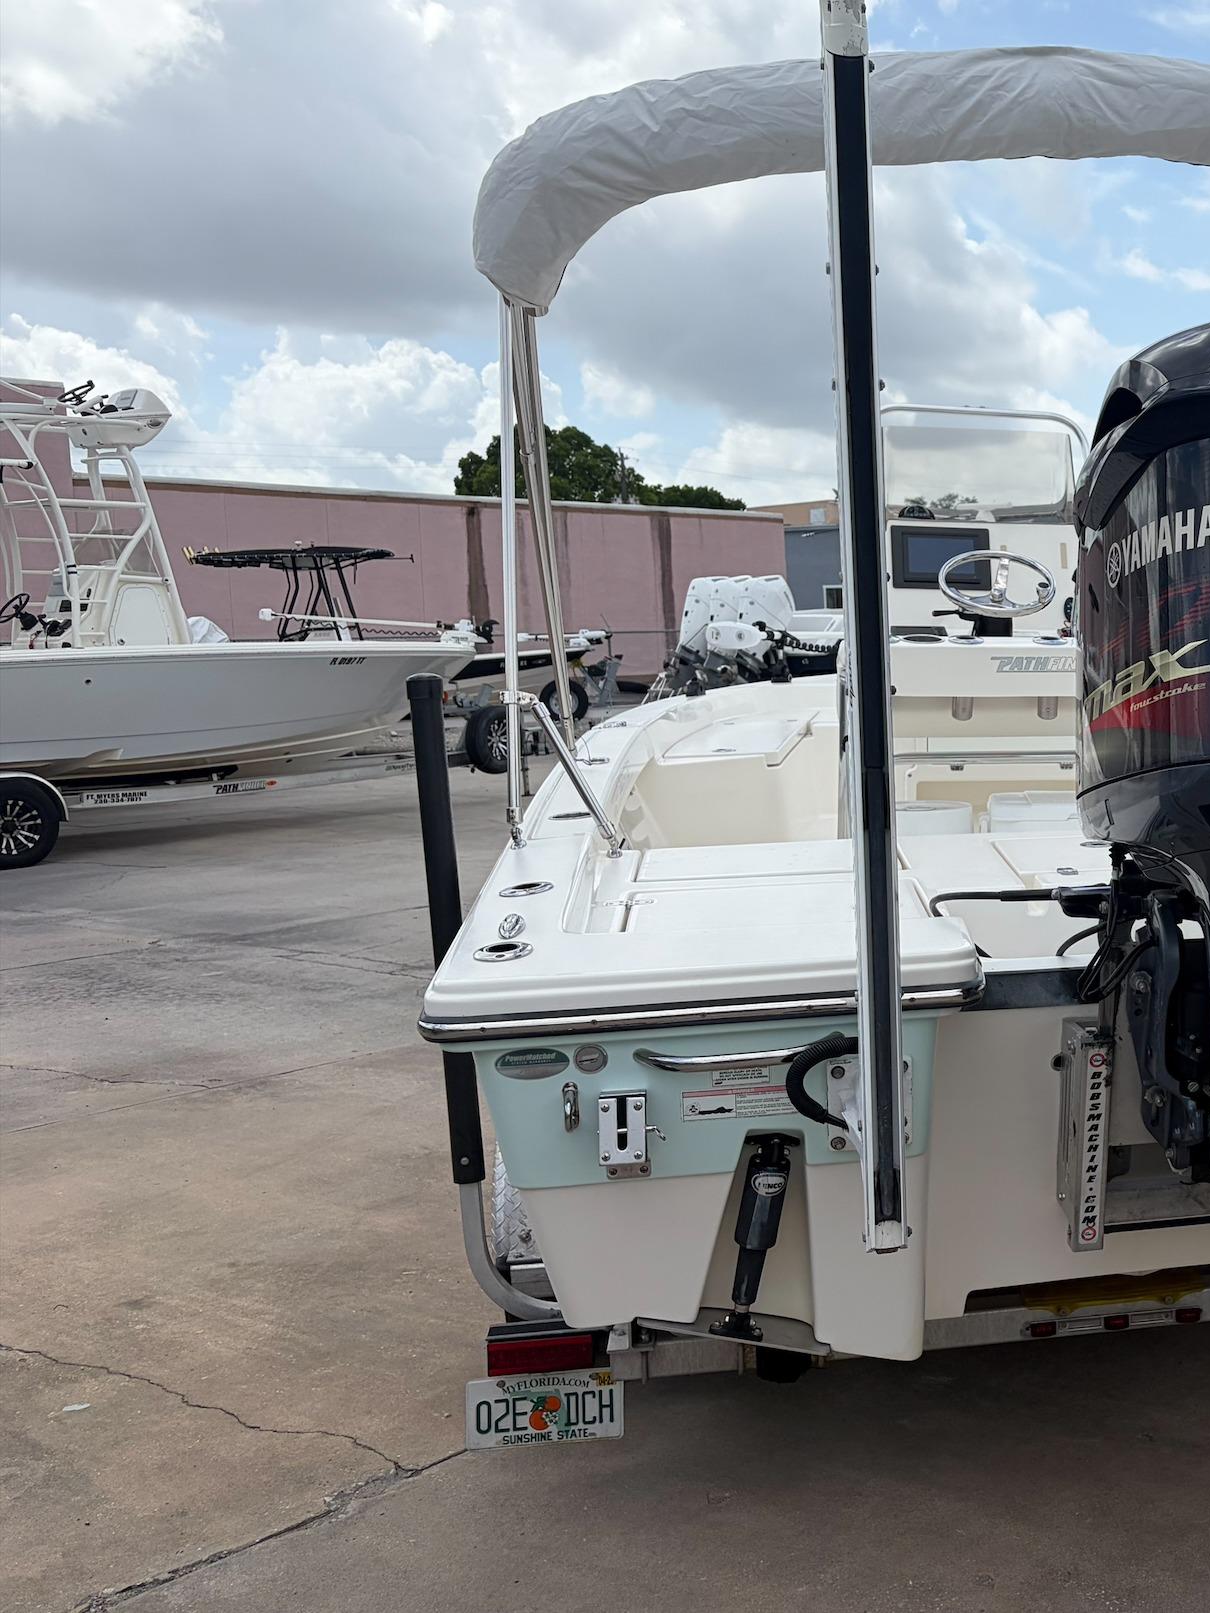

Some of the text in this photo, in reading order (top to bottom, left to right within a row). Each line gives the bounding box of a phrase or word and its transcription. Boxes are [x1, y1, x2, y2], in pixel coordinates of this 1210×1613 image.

[501, 1377, 591, 1395] MYFLORIDA.COM
[564, 1388, 615, 1427] DCH
[502, 1428, 589, 1445] SUNSHINE STATE
